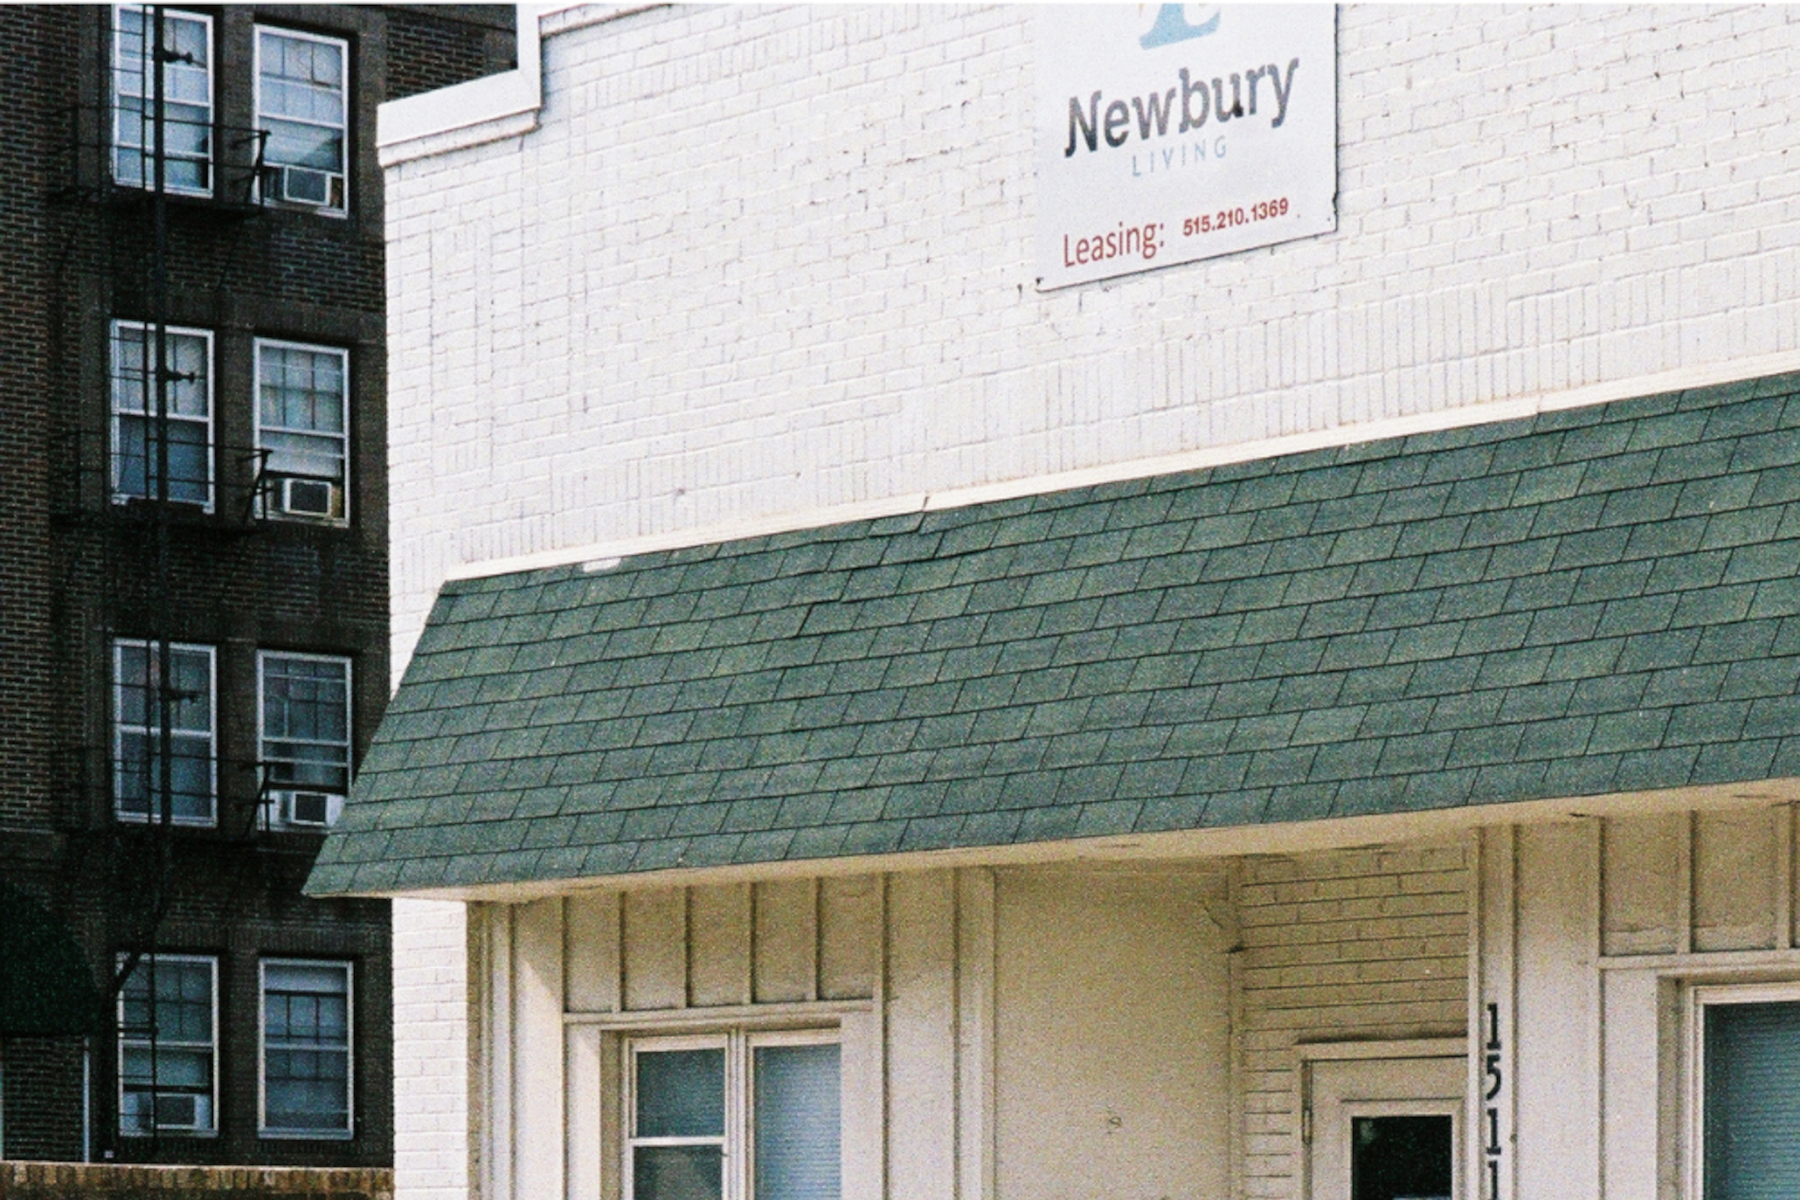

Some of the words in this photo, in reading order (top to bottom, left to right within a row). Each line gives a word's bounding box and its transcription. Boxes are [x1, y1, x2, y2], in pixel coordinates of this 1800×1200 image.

[1064, 57, 1300, 158] Newbury
[1132, 135, 1227, 177] LIVING
[1063, 221, 1165, 267] Leasing:
[1182, 197, 1289, 237] 515.210.1369
